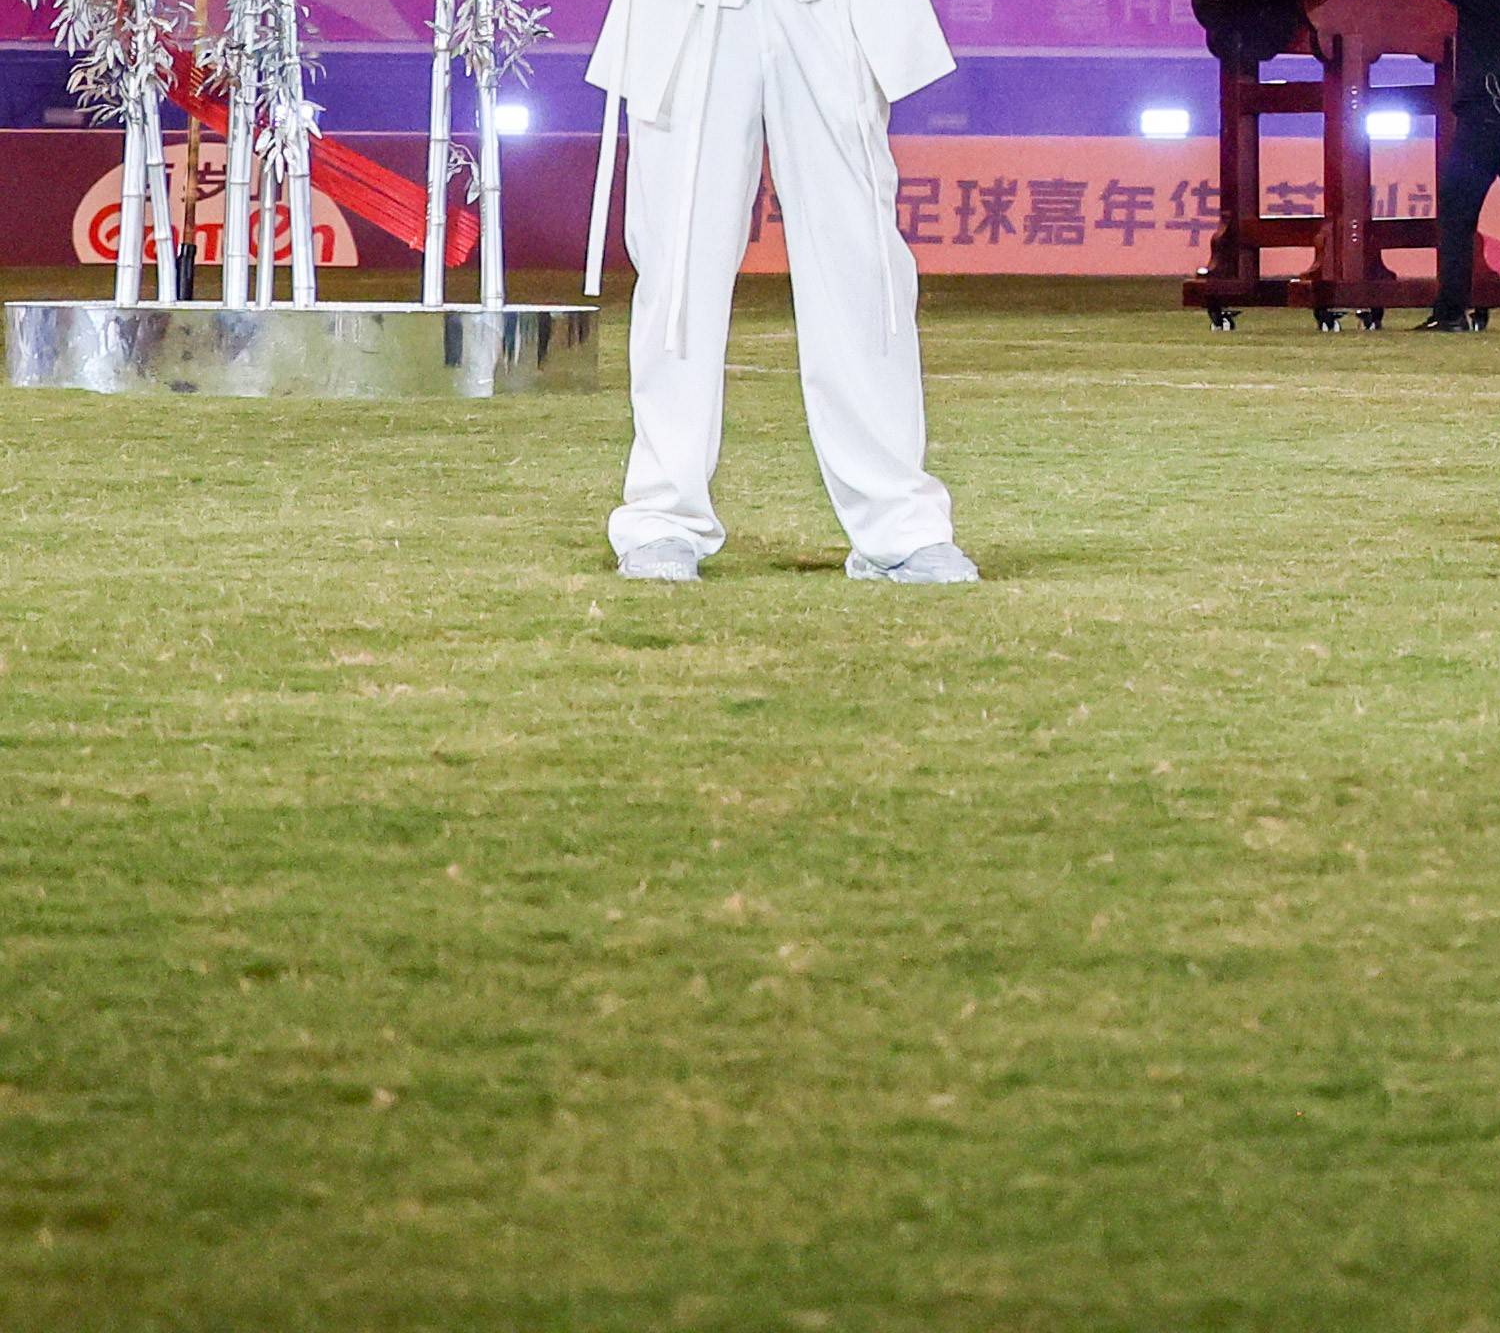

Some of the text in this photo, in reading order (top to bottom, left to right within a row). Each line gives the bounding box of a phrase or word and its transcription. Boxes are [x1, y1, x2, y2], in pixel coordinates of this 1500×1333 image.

[750, 176, 1222, 247] 足球嘉年华
